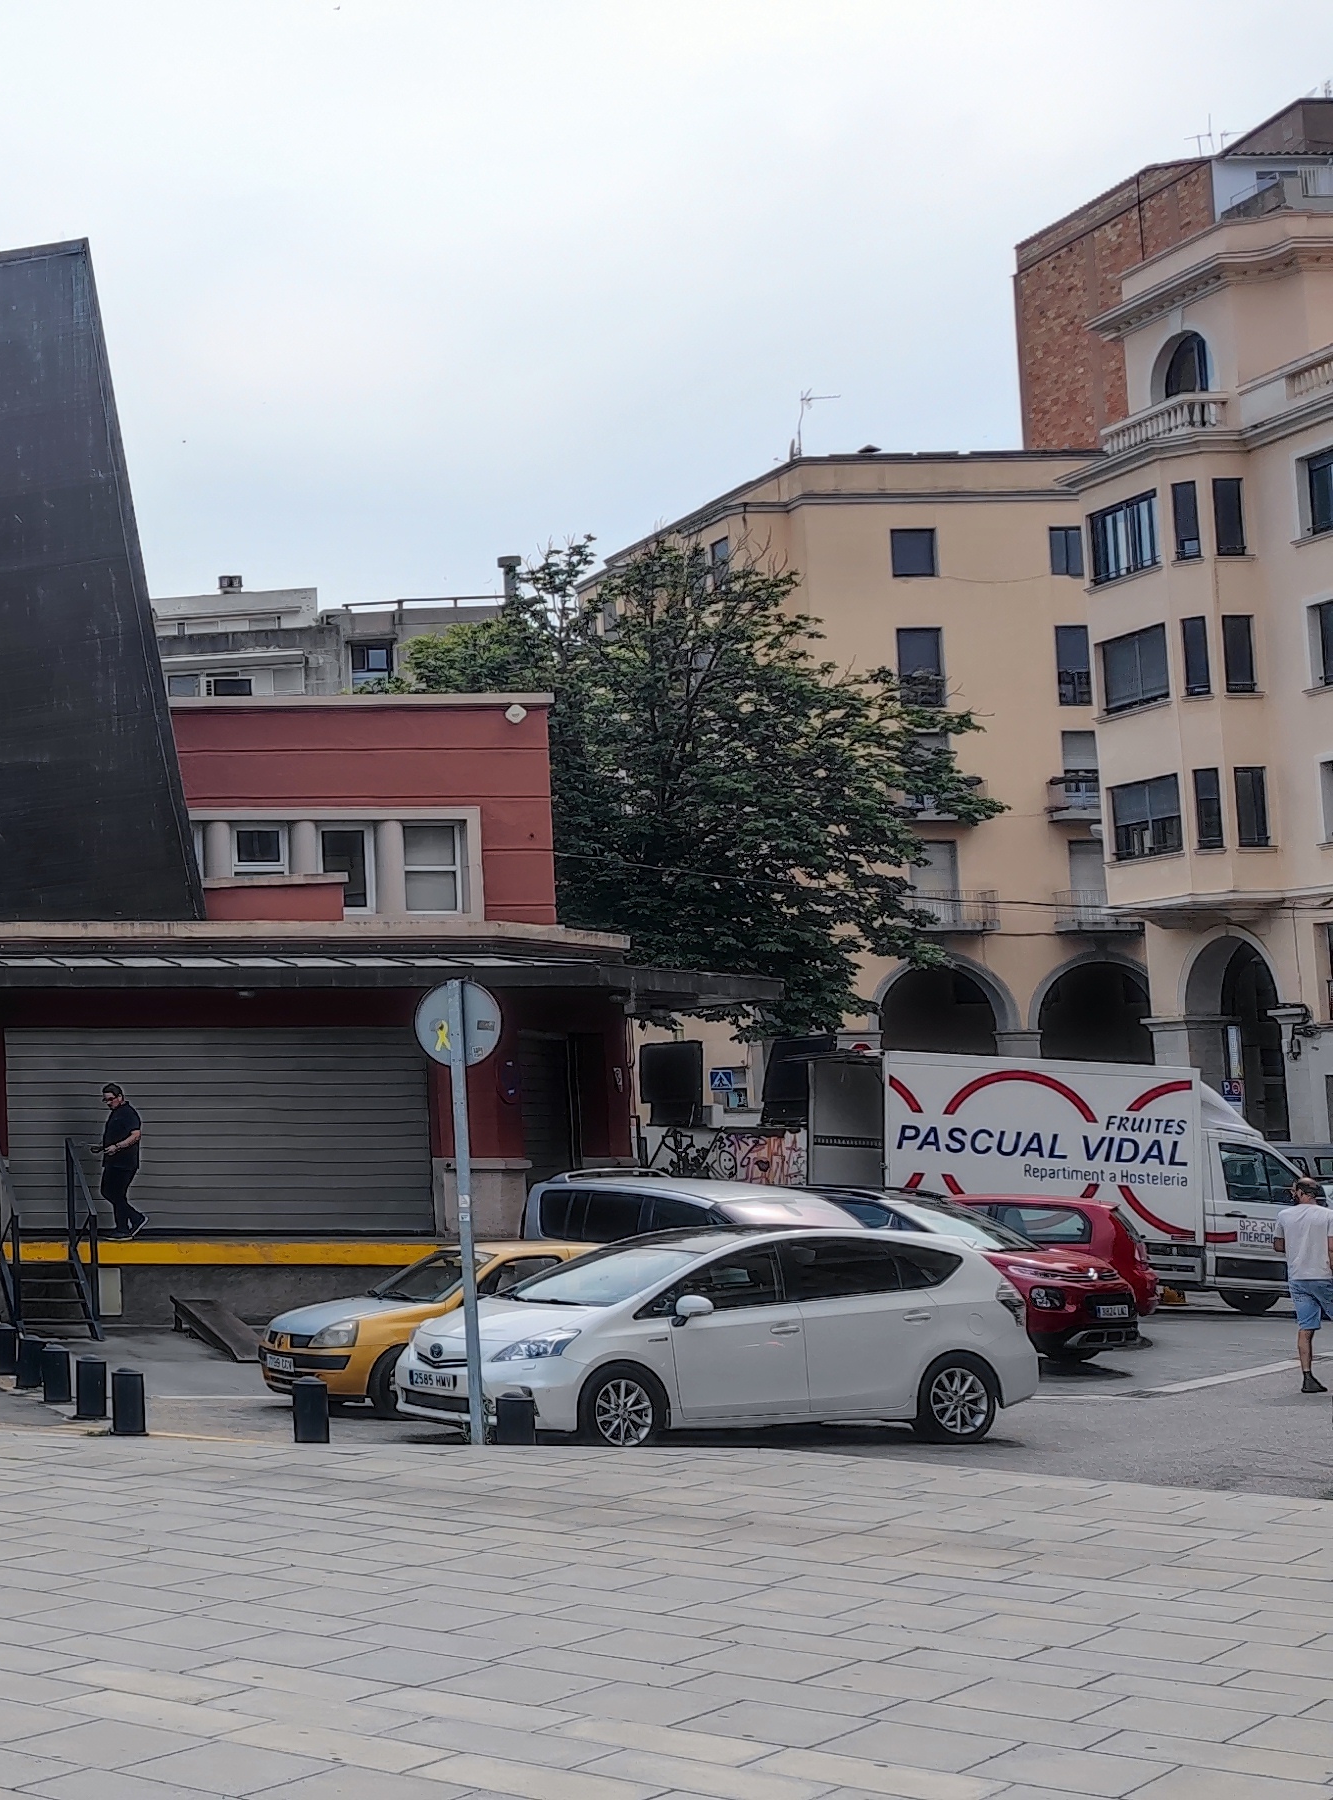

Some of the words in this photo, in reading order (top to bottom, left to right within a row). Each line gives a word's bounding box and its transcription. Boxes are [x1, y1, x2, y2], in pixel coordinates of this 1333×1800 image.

[1222, 1081, 1231, 1095] P
[1105, 1115, 1188, 1136] FRUITES
[897, 1124, 1068, 1160] PASCUAL
[1082, 1134, 1189, 1167] VIDAL
[1023, 1163, 1106, 1185] Repartiment
[1109, 1173, 1117, 1183] a
[1120, 1169, 1189, 1188] Hosteleria
[414, 1372, 434, 1385] 2585
[435, 1375, 452, 1388] HMV
